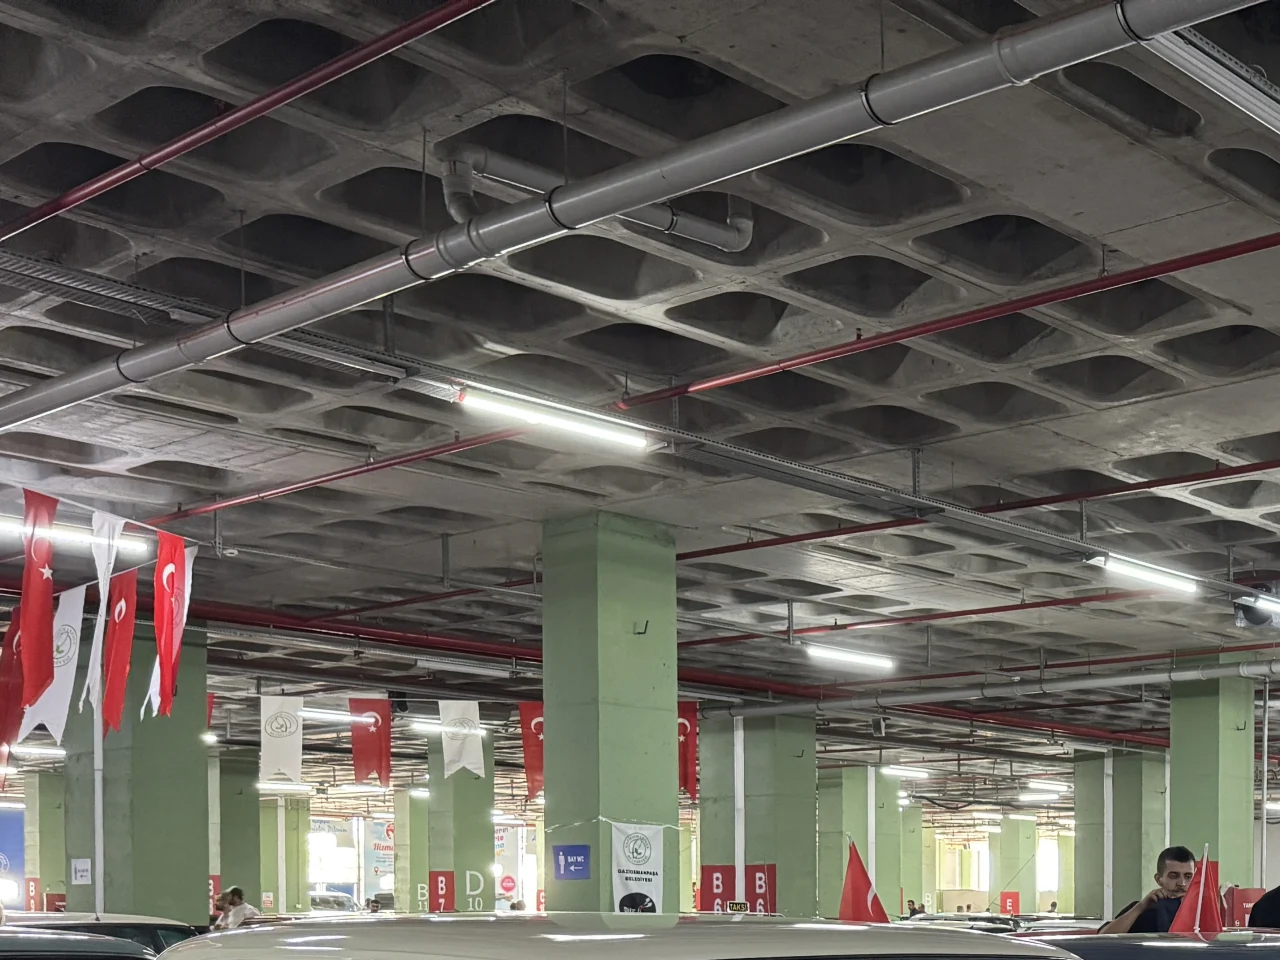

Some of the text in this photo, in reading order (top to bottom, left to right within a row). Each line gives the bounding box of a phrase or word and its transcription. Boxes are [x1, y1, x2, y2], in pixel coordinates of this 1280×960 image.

[417, 883, 429, 901] B
[437, 876, 446, 895] B
[465, 870, 485, 895] D
[712, 872, 723, 894] B
[755, 872, 766, 894] B
[438, 898, 446, 913] 7
[467, 897, 484, 911] 10
